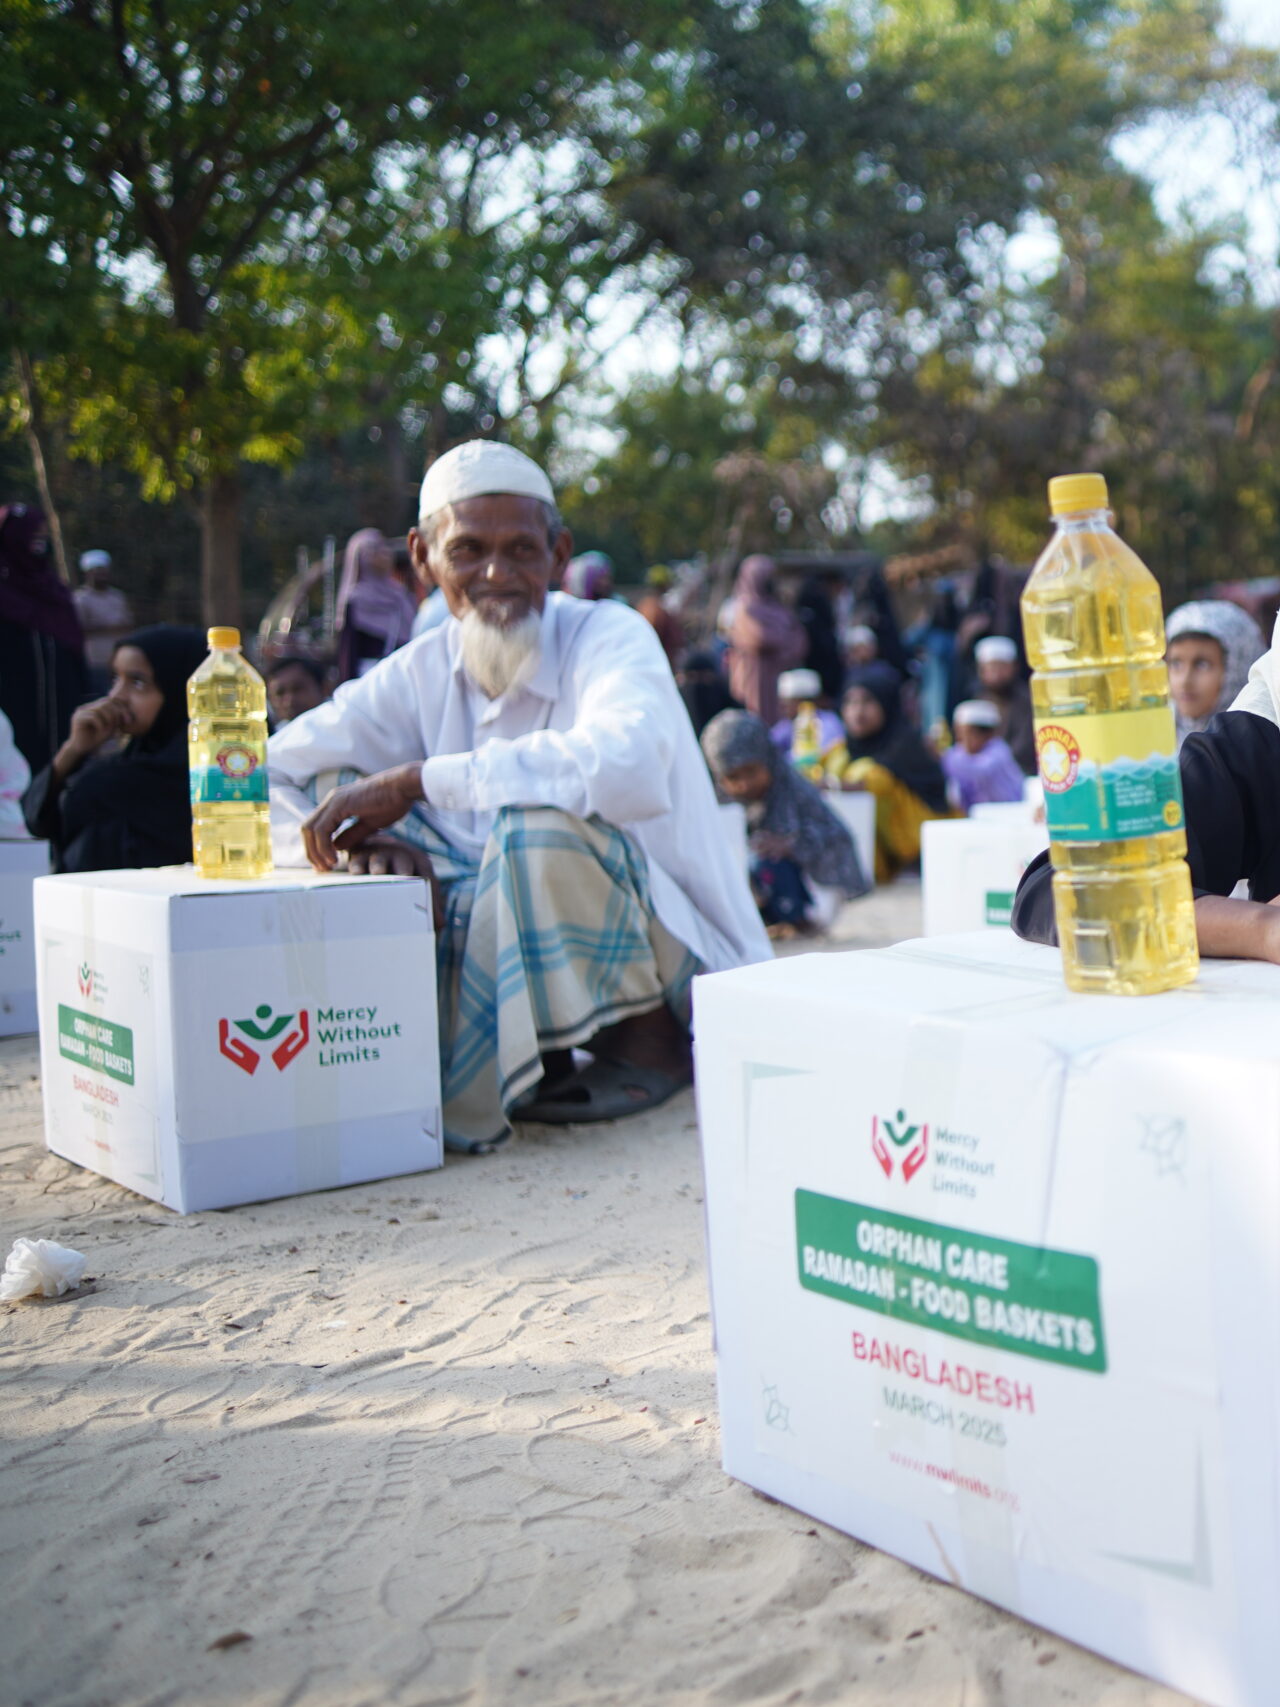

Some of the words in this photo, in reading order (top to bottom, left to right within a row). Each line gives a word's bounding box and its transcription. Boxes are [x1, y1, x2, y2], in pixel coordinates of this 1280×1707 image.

[318, 1006, 377, 1024] Mercy
[98, 1026, 113, 1047] CARE
[317, 1022, 402, 1044] Without
[105, 1050, 132, 1077] BASKETS
[319, 1046, 380, 1067] Limits
[73, 1074, 119, 1107] BANGLADESH
[936, 1126, 980, 1153] Mercy
[935, 1150, 995, 1177] Without
[933, 1175, 977, 1199] Limits
[857, 1220, 942, 1272] ORPHAN
[947, 1244, 1009, 1290] CARE
[802, 1246, 896, 1301] RAMADAN
[911, 1277, 970, 1324] FOOD
[974, 1296, 1097, 1355] BASKETS
[852, 1330, 1036, 1414] BANGLADESH
[883, 1385, 954, 1430] MARCH
[958, 1411, 1008, 1449] 2025
